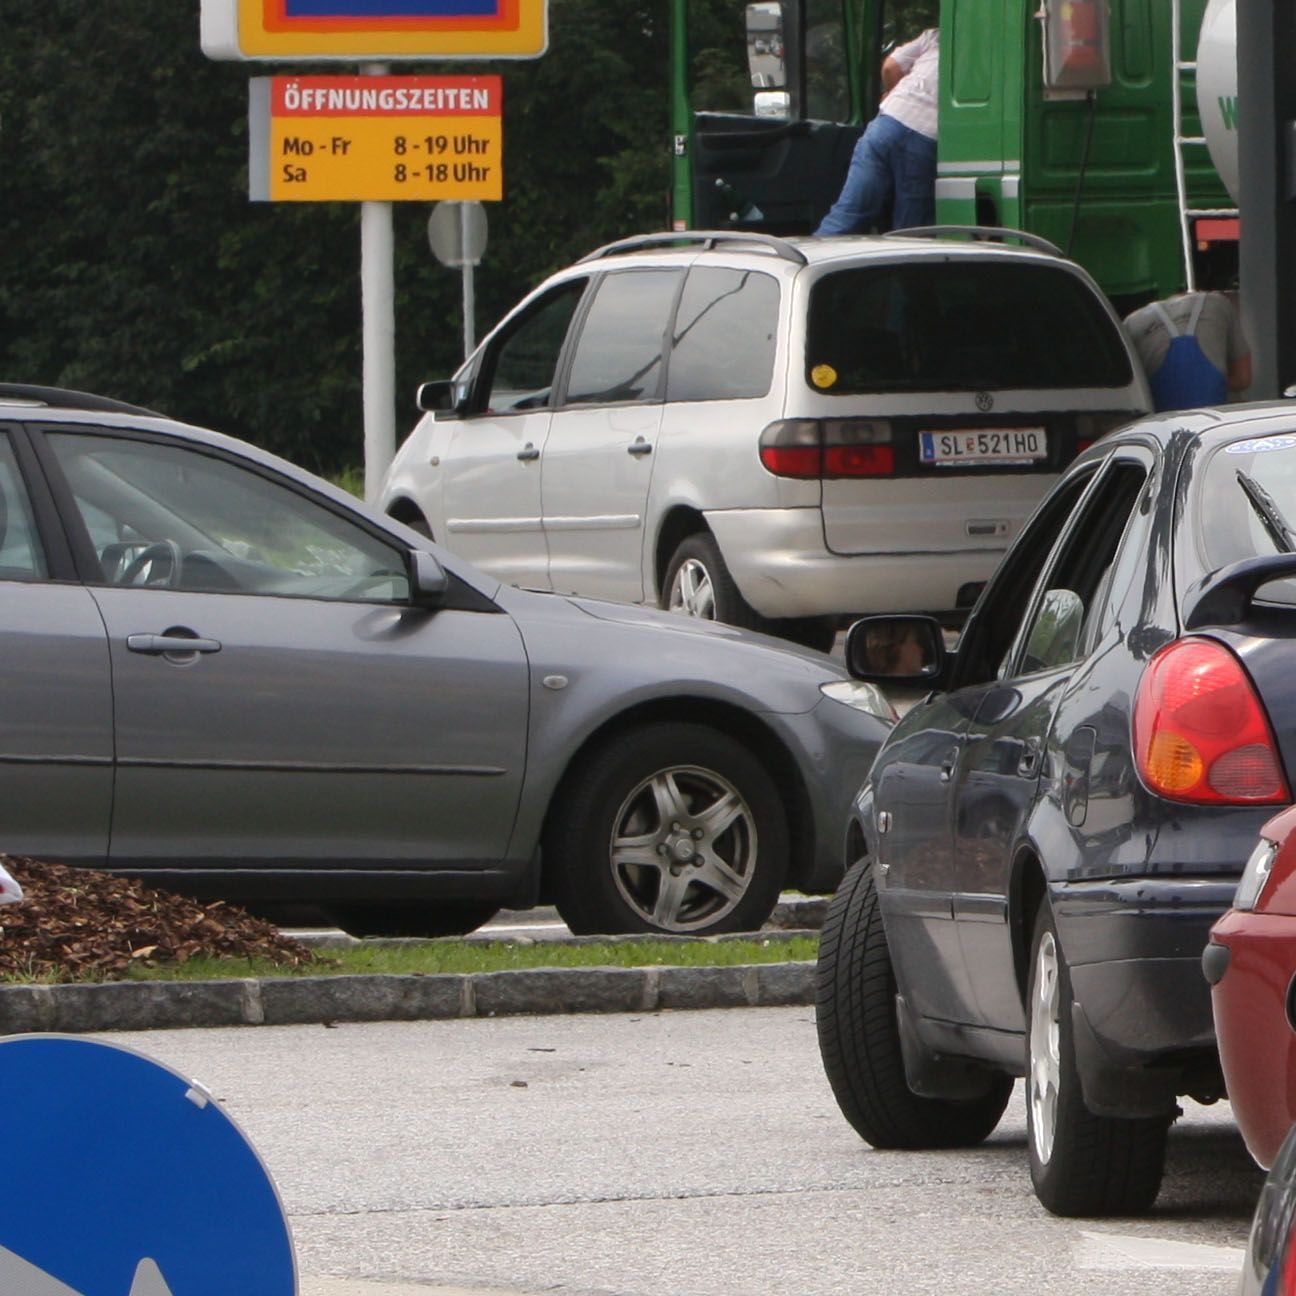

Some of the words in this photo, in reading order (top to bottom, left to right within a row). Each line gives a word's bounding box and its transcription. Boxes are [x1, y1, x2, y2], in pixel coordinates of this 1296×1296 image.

[284, 83, 489, 112] ÖFFNUNGSZEITEN
[283, 136, 314, 156] Mo
[332, 136, 352, 156] Fr
[394, 136, 407, 156] 8
[425, 135, 449, 155] 19
[453, 134, 490, 155] Uhr
[283, 163, 307, 183] Sa
[394, 163, 407, 182] 8
[426, 162, 449, 182] 18
[453, 162, 490, 182] Uhr
[941, 435, 964, 456] SL
